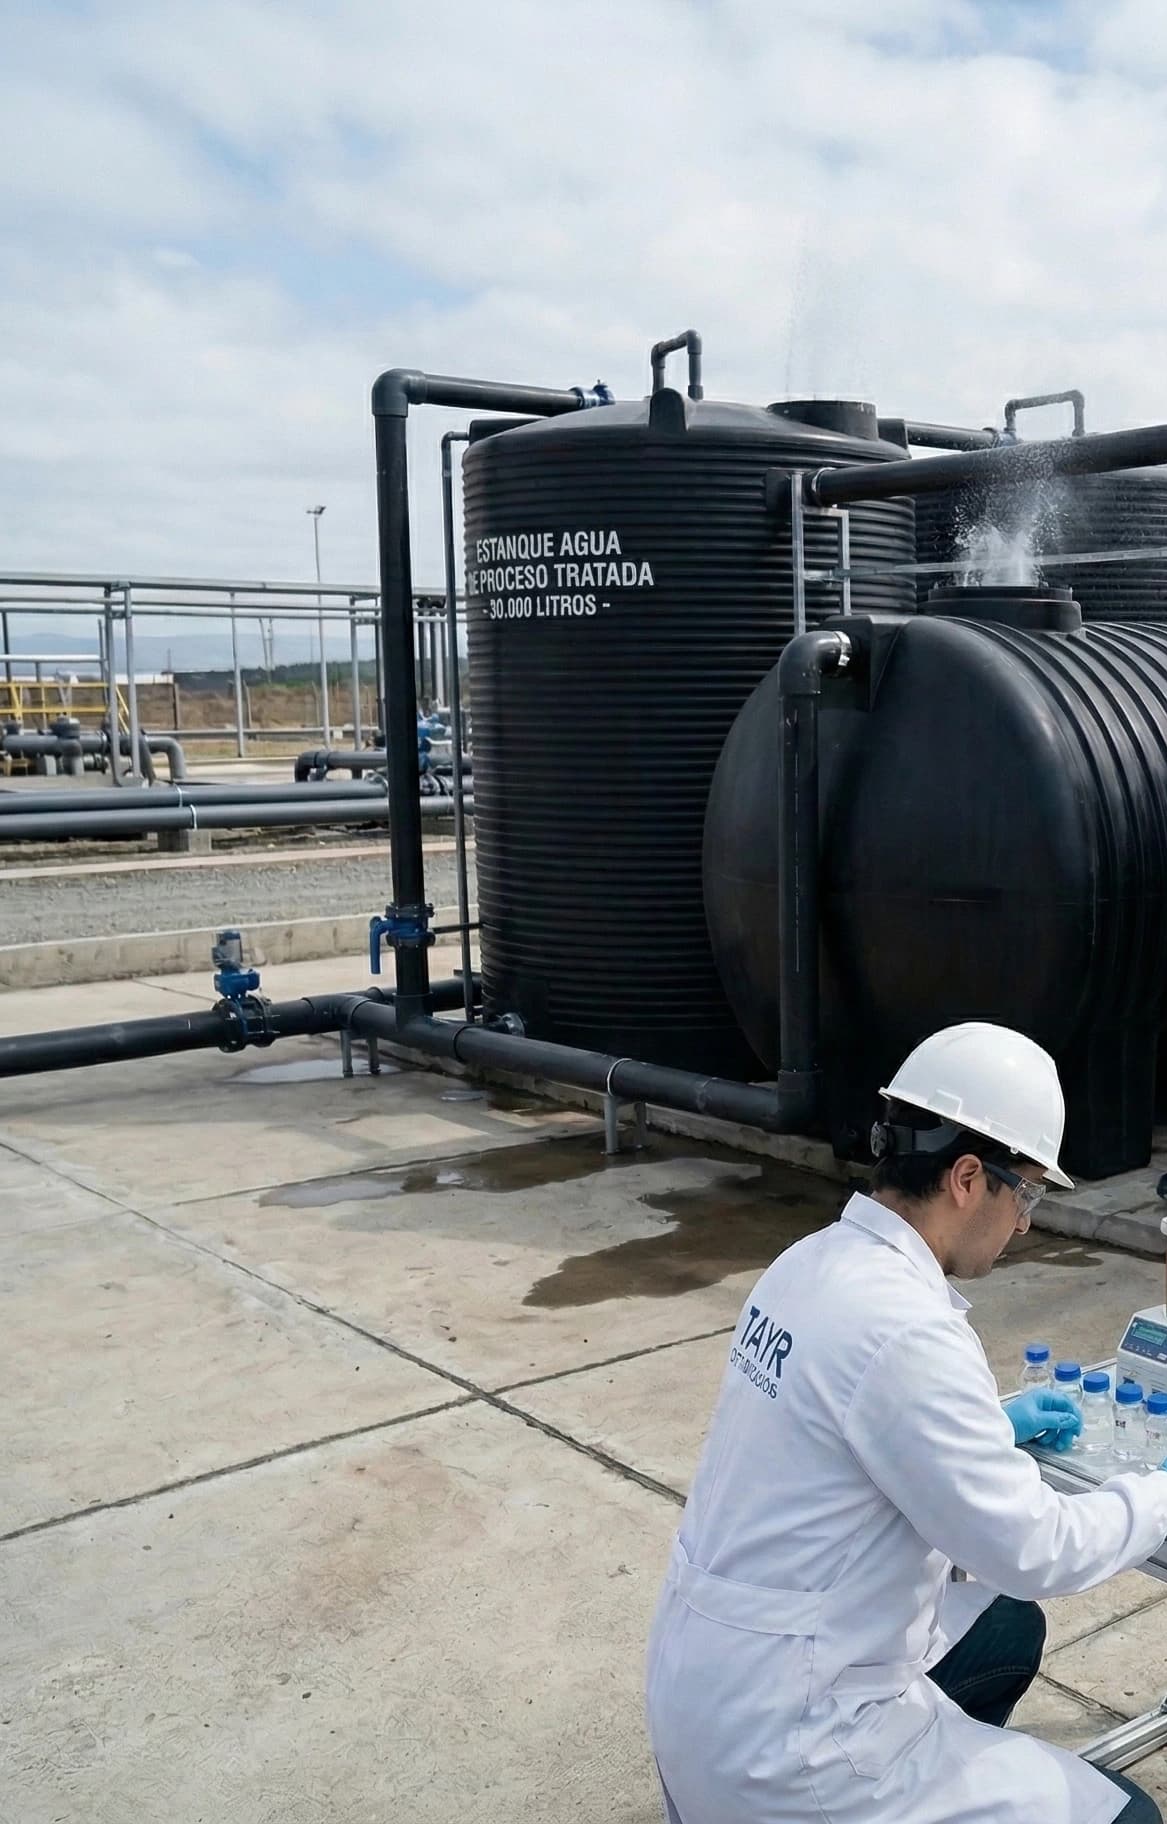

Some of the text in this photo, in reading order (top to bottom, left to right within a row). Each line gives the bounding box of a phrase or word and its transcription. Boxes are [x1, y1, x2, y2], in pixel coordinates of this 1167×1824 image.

[477, 531, 621, 563] ESTANQUE AGUA
[480, 564, 548, 593] PROCESO
[554, 562, 654, 588] TRATADA
[490, 596, 532, 619] 30.000
[536, 595, 597, 617] LITROS
[741, 1305, 793, 1379] TAYR
